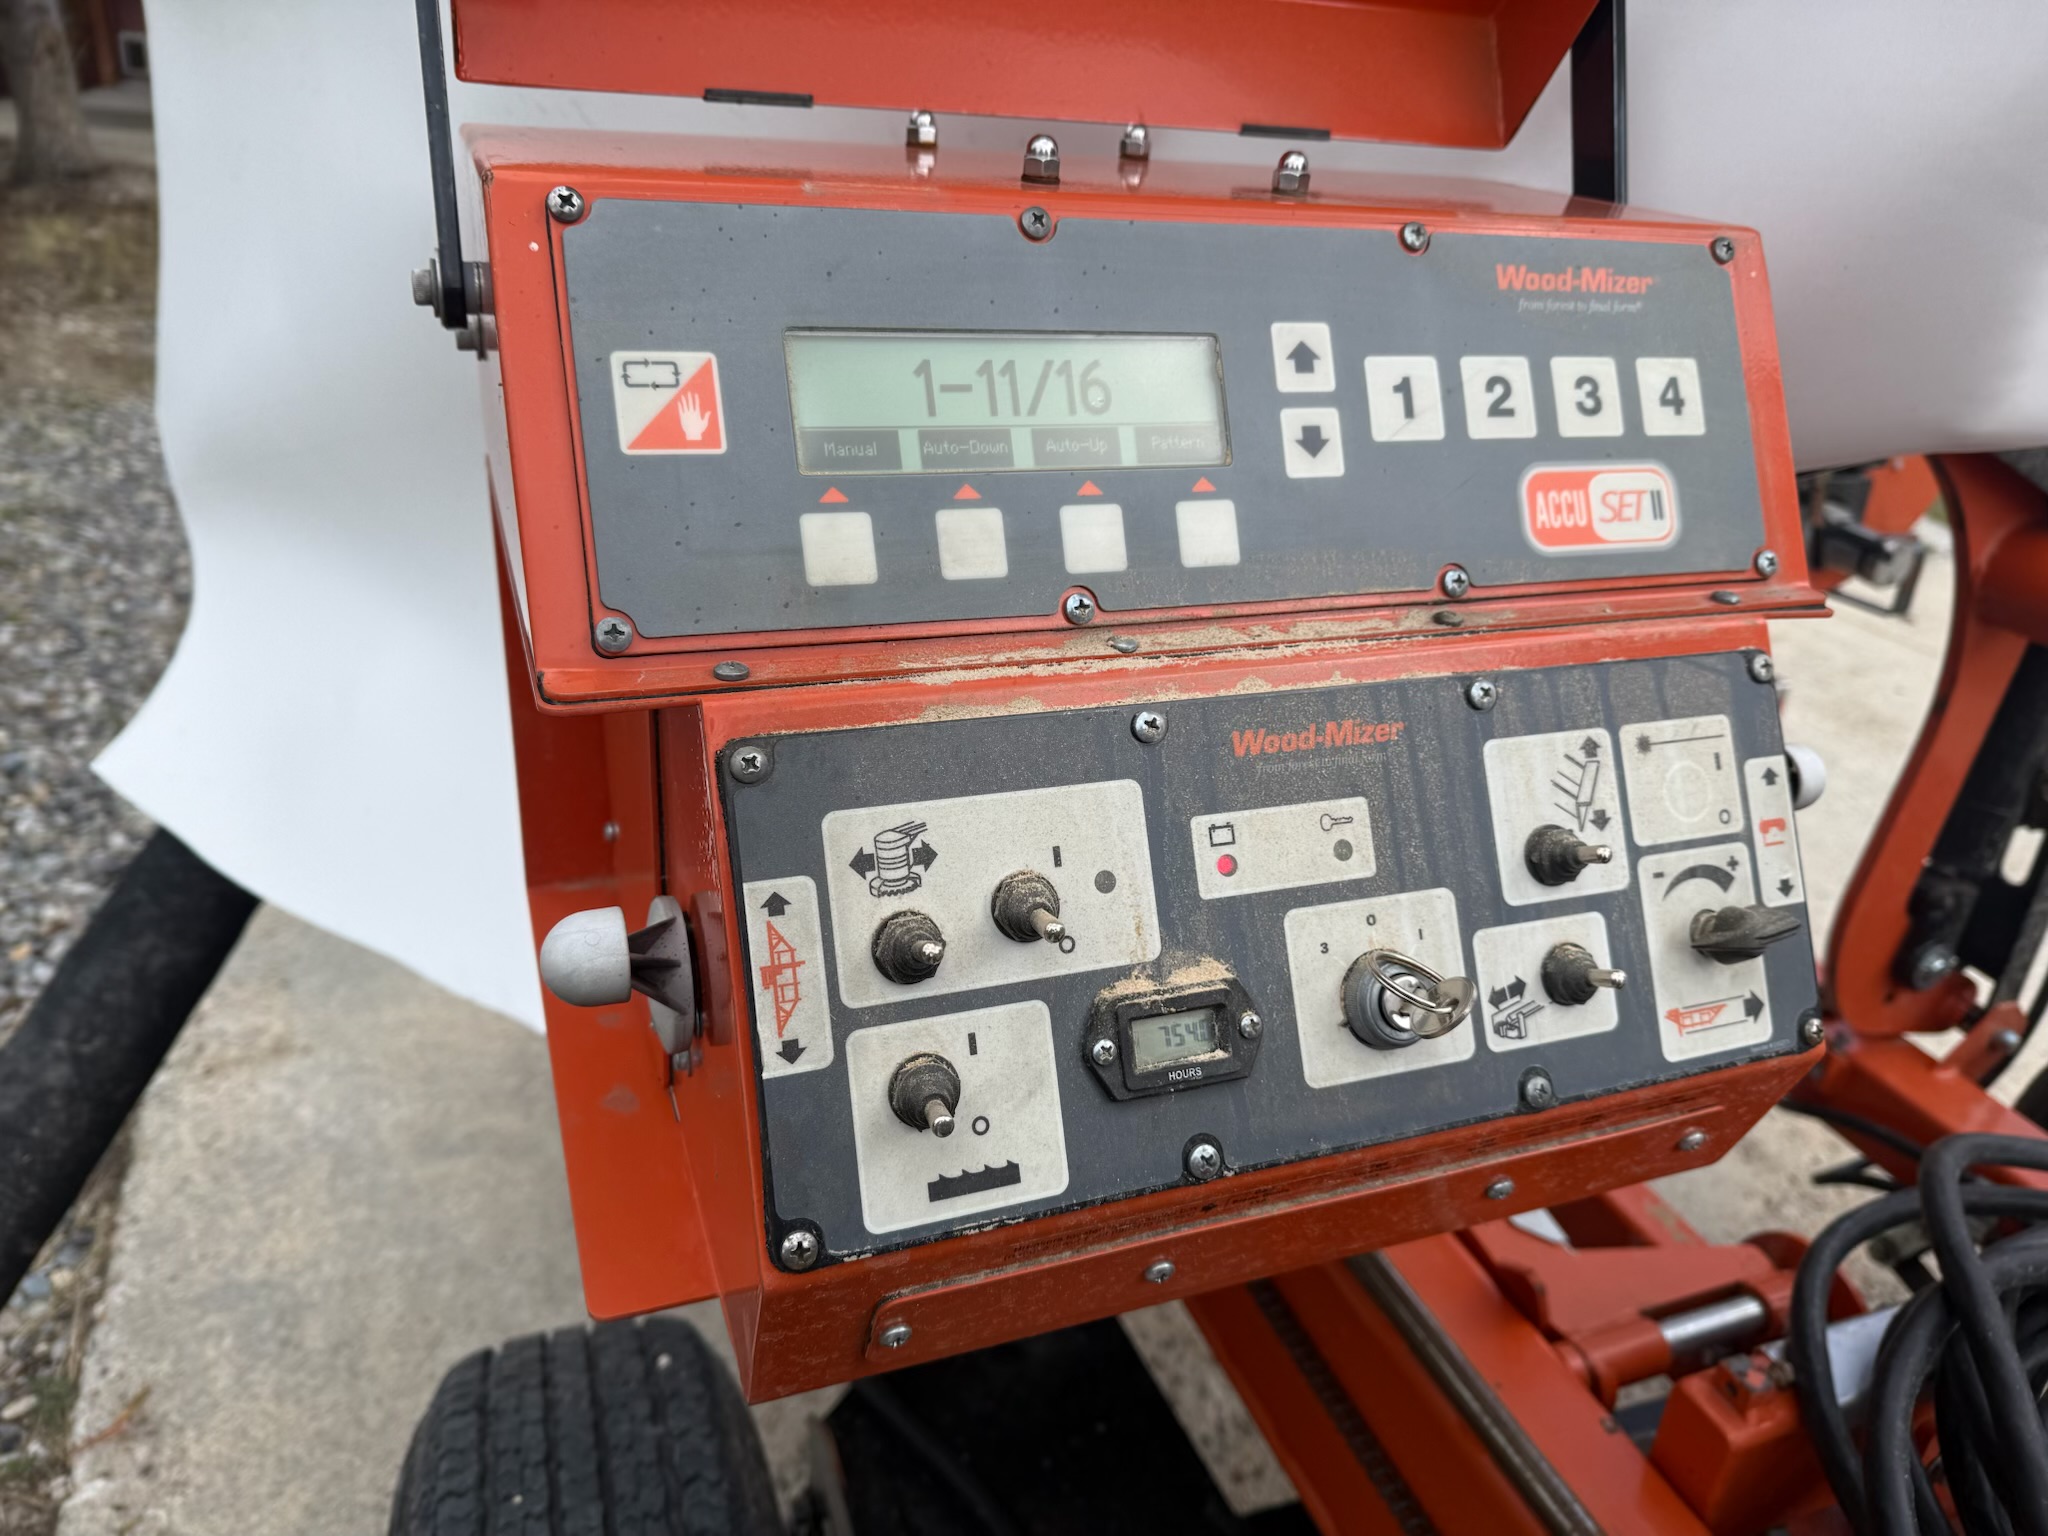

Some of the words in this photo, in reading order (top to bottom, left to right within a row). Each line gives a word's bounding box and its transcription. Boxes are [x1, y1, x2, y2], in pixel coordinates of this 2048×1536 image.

[1496, 264, 1653, 295] Wood-Mizer
[912, 359, 1113, 417] 1-11/16
[1392, 376, 1415, 419] 1
[1485, 375, 1515, 418] 2
[1574, 375, 1603, 417] 3
[1659, 376, 1685, 416] 4
[824, 441, 878, 457] Manual
[923, 440, 1009, 455] Auto-Down
[1046, 438, 1108, 455] Auto-Up
[1152, 436, 1203, 450] Pattern
[1536, 490, 1588, 529] ACCU
[1600, 490, 1648, 523] SET
[1231, 719, 1406, 758] Wood-Mizer
[1320, 942, 1329, 954] 3
[1168, 1066, 1203, 1081] HOURS
